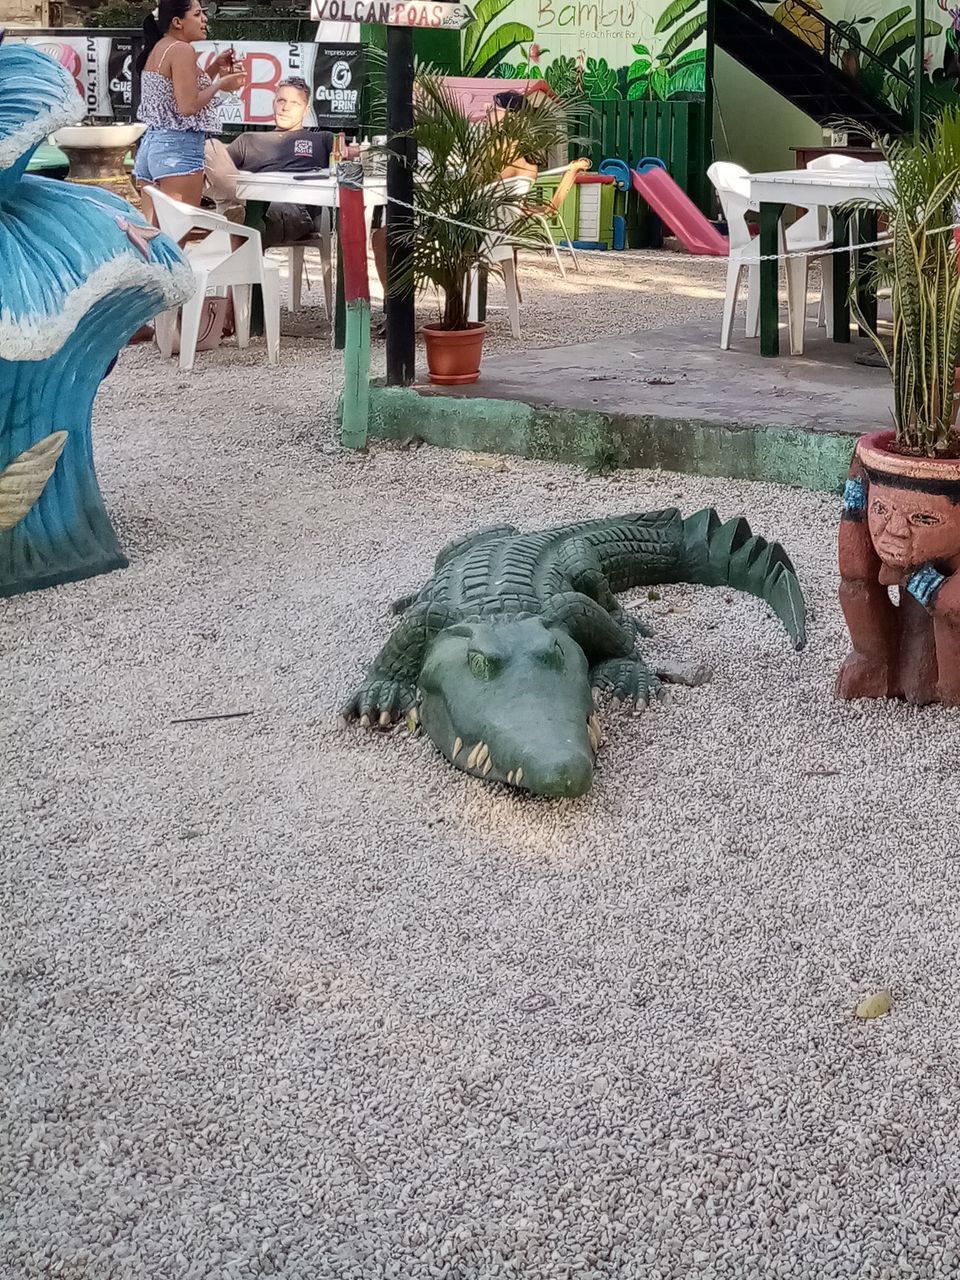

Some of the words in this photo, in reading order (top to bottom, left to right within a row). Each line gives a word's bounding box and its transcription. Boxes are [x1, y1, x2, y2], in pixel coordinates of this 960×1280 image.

[314, 0, 390, 24] VOLCAN
[394, 3, 443, 27] POAS
[86, 36, 98, 63] FM
[86, 68, 98, 115] 104.1
[110, 78, 132, 92] Gua
[315, 85, 358, 101] Guana
[331, 100, 356, 113] PRINT
